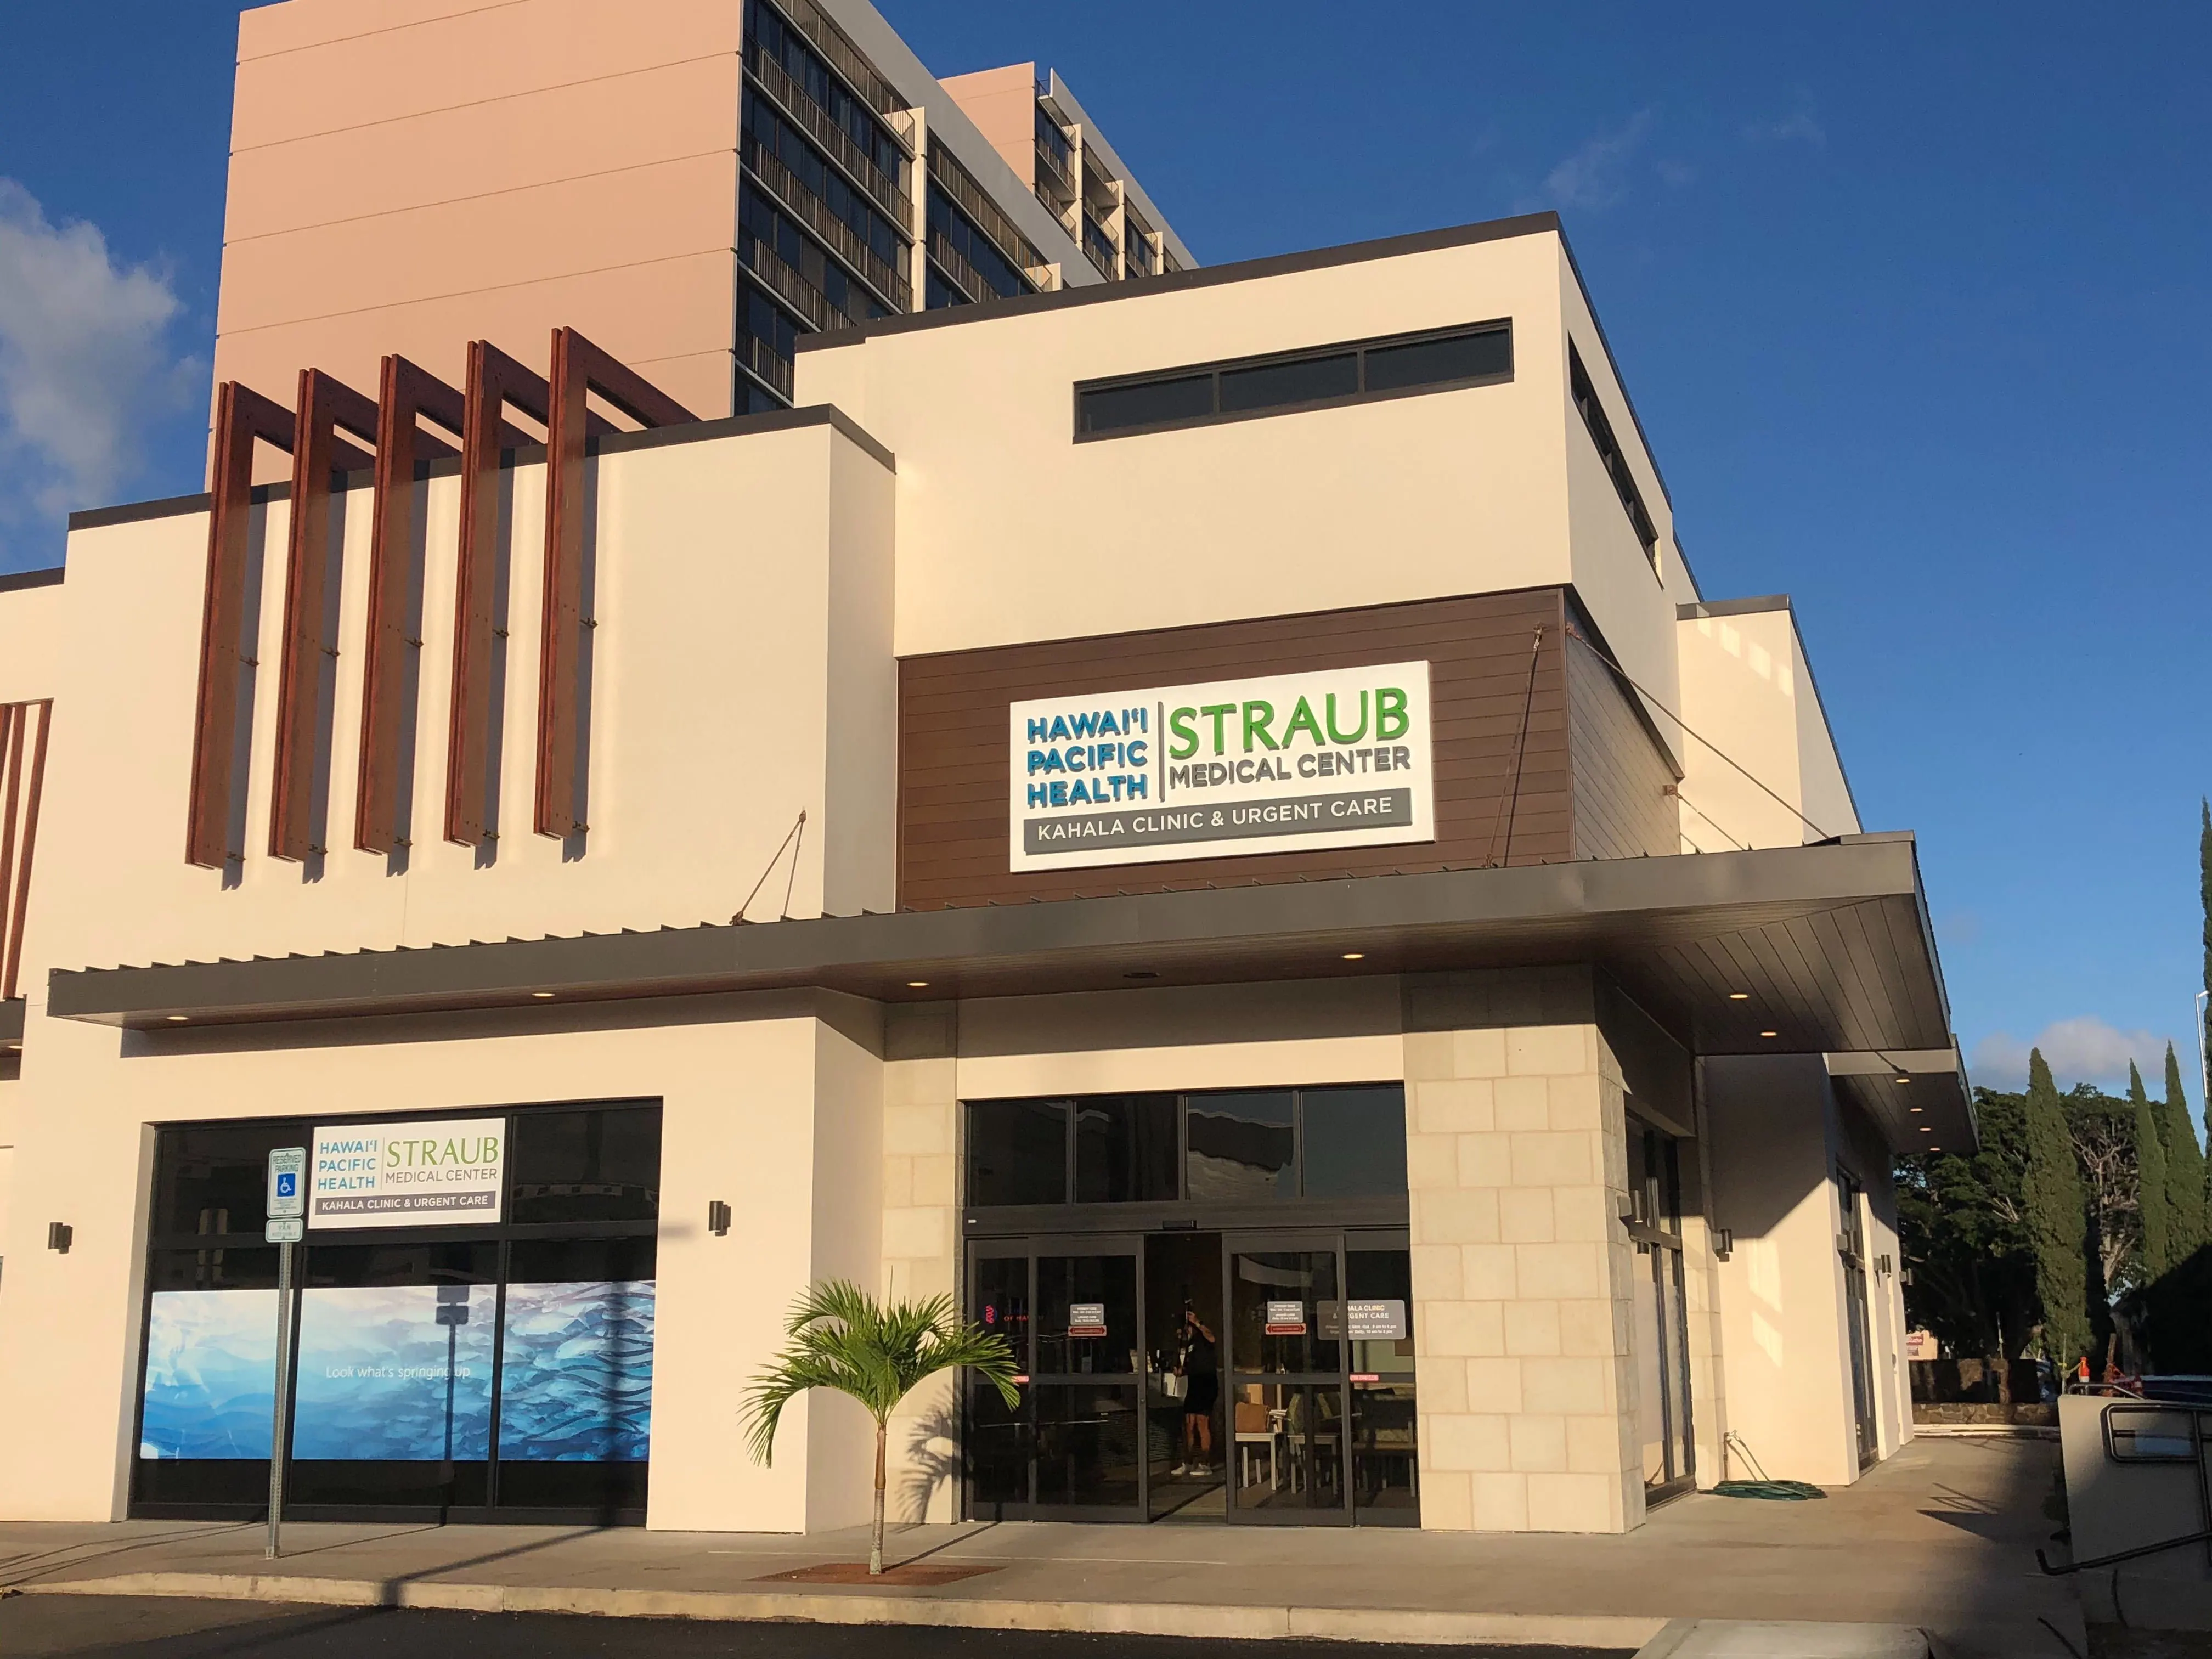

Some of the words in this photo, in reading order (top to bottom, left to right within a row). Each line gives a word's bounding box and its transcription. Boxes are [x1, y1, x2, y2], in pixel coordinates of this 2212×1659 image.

[1169, 687, 1410, 760] STRAUB
[1026, 740, 1148, 776] PACIFIC
[1170, 756, 1292, 790] MEDICAL
[1297, 746, 1411, 778] CENTER
[1026, 774, 1148, 809] HEALTH
[1037, 815, 1125, 840] KAHALA
[1133, 812, 1204, 834] CLINIC
[1211, 811, 1224, 827] &
[1233, 803, 1323, 826] URGENT
[1330, 797, 1393, 817] CARE
[319, 1158, 376, 1172] PACIFIC
[387, 1137, 499, 1167] STRAUB
[318, 1176, 375, 1190] HEALTH
[386, 1170, 443, 1184] MEDICAL
[446, 1168, 498, 1181] CENTER
[322, 1200, 364, 1211] KAHALA
[367, 1198, 402, 1209] CLINIC
[404, 1198, 411, 1208] &
[414, 1197, 456, 1207] URGENT
[459, 1195, 488, 1205] CARE
[326, 1366, 354, 1378] Look
[357, 1365, 393, 1378] what's
[398, 1364, 450, 1380] springing
[454, 1366, 470, 1380] up
